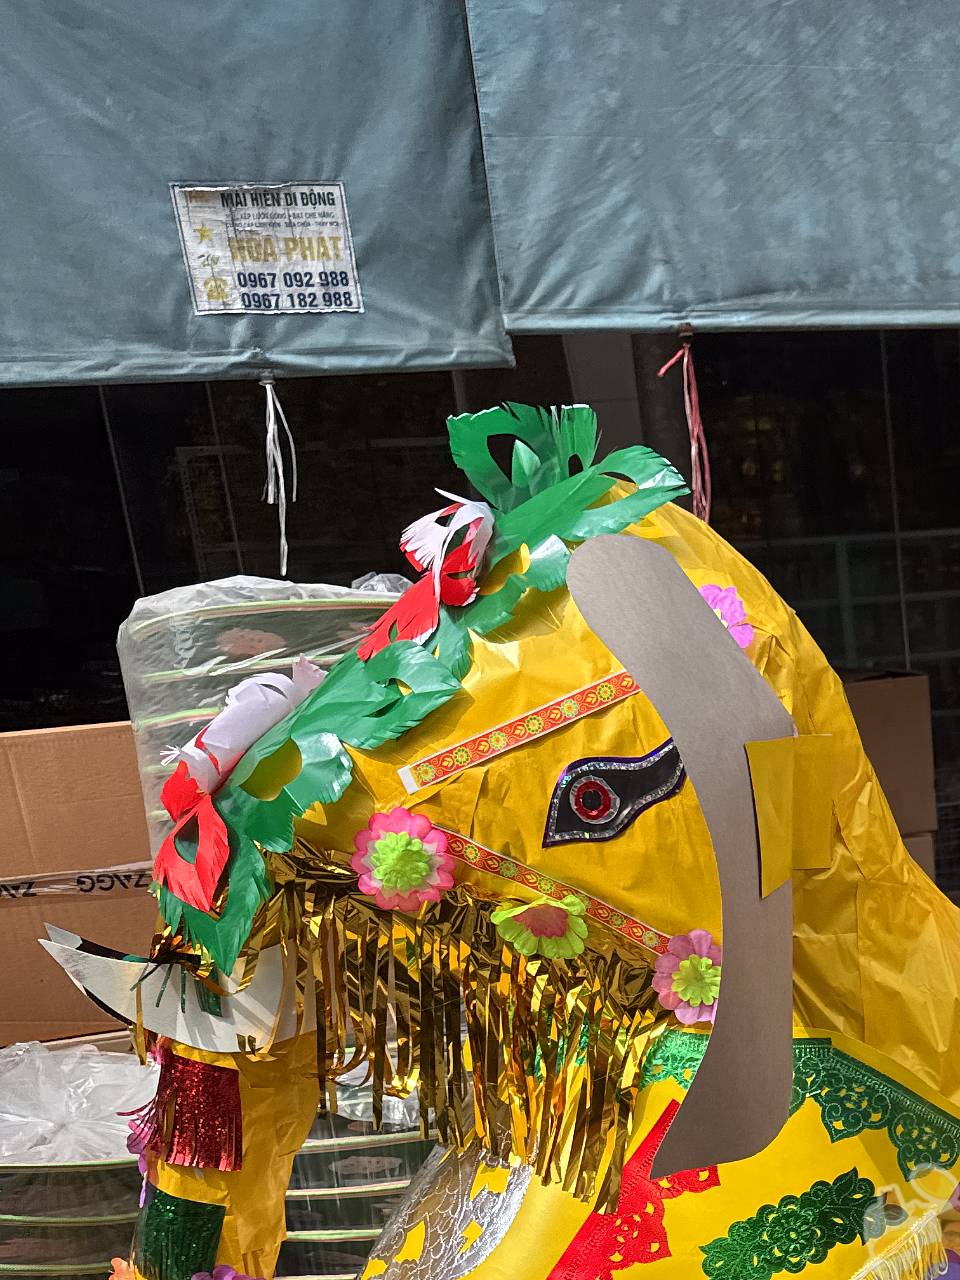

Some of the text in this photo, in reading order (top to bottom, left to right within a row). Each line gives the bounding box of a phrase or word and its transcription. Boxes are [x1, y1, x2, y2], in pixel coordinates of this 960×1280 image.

[284, 191, 298, 206] DI
[300, 188, 335, 210] ĐỘNG
[237, 270, 349, 289] 0967 092 988
[241, 291, 353, 309] 0967 182 988
[76, 873, 149, 893] ZAGG
